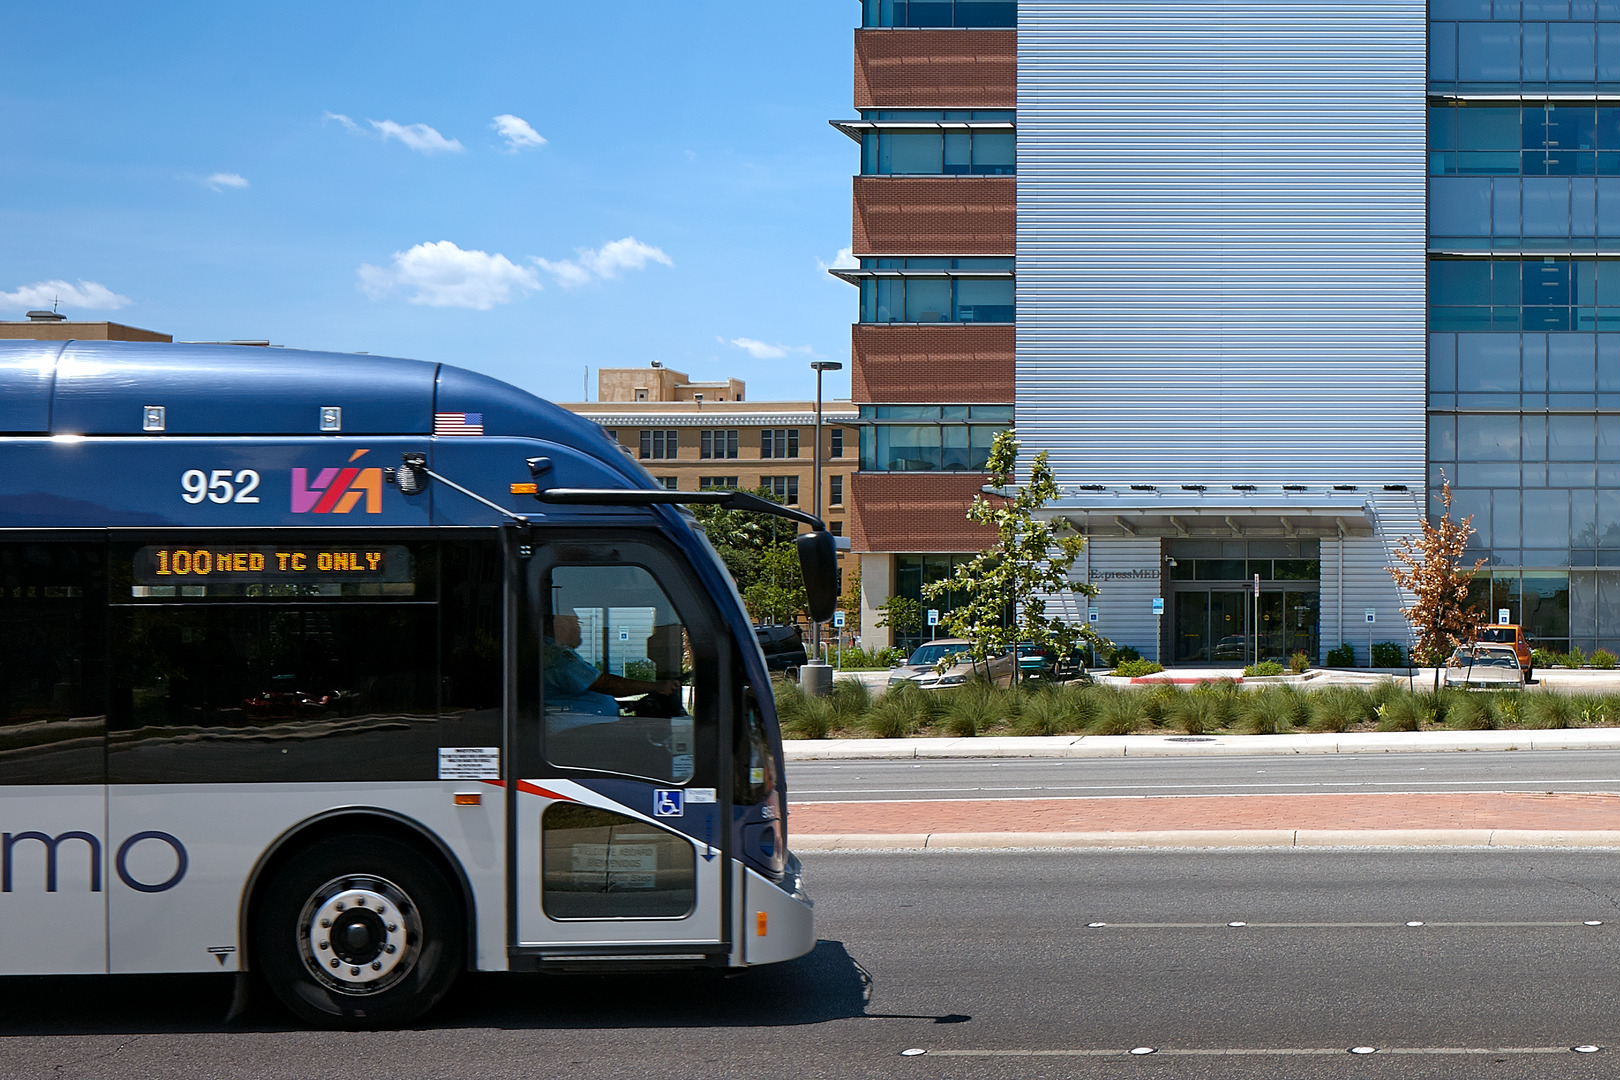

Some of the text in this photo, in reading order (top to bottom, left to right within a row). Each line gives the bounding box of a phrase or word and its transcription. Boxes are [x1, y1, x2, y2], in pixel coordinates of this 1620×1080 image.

[180, 469, 261, 504] 952
[156, 550, 382, 575] 100 MED TC ONLY
[1089, 569, 1160, 581] ExpressMED
[1, 830, 189, 893] mo
